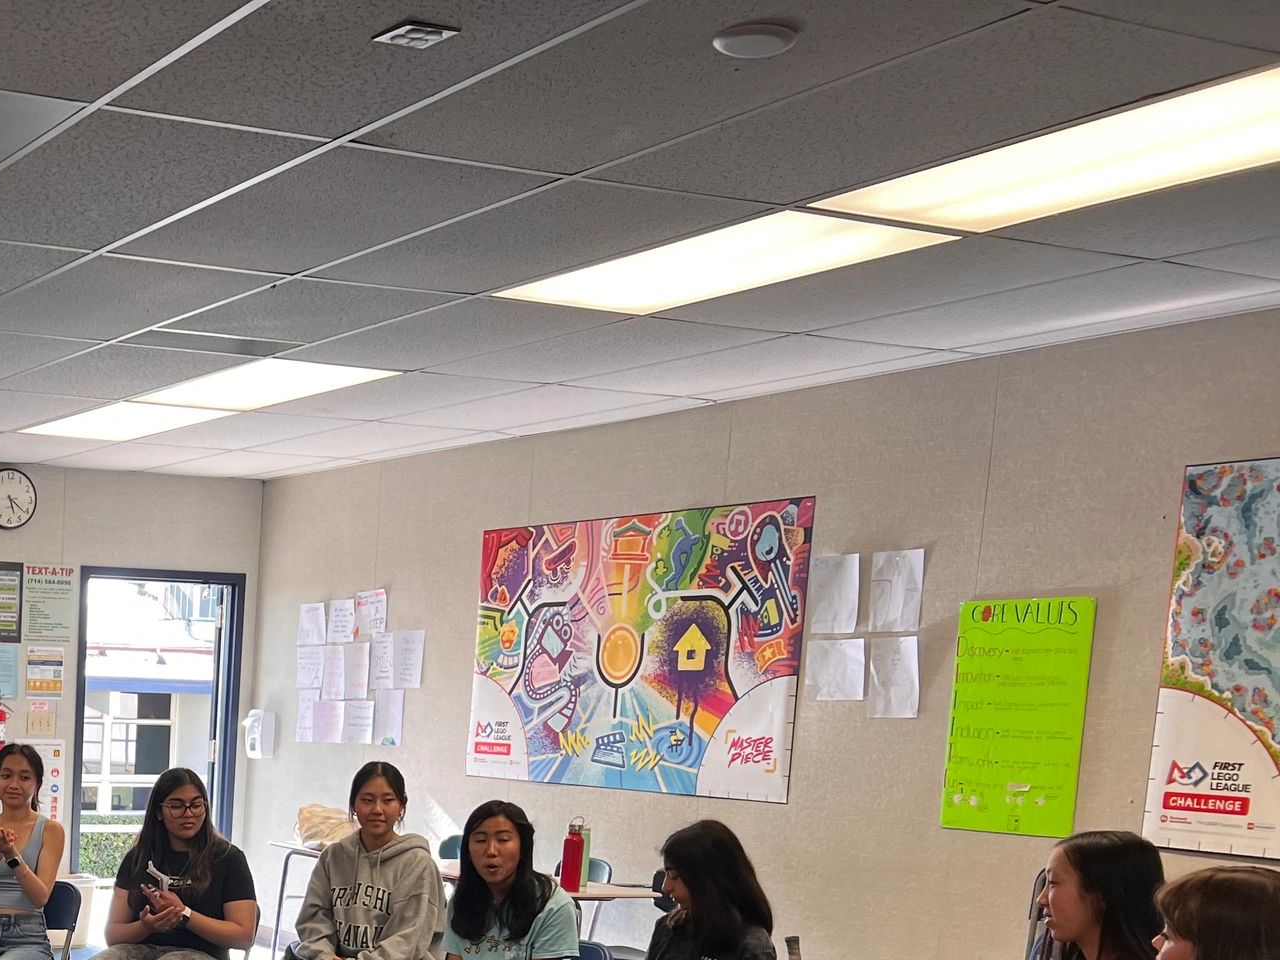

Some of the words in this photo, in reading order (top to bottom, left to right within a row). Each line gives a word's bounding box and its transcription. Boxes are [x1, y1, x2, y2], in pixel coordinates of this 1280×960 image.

[25, 566, 74, 577] TEXT-A-TIP
[27, 578, 43, 586] (714)
[1015, 601, 1078, 625] VALUES
[476, 745, 508, 753] CHALLENGE
[728, 736, 773, 755] MASTER
[1213, 762, 1244, 771] FIRST
[1211, 772, 1239, 781] LEGO
[1210, 782, 1252, 792] LEAGUE
[1169, 797, 1243, 811] CHALLENGE
